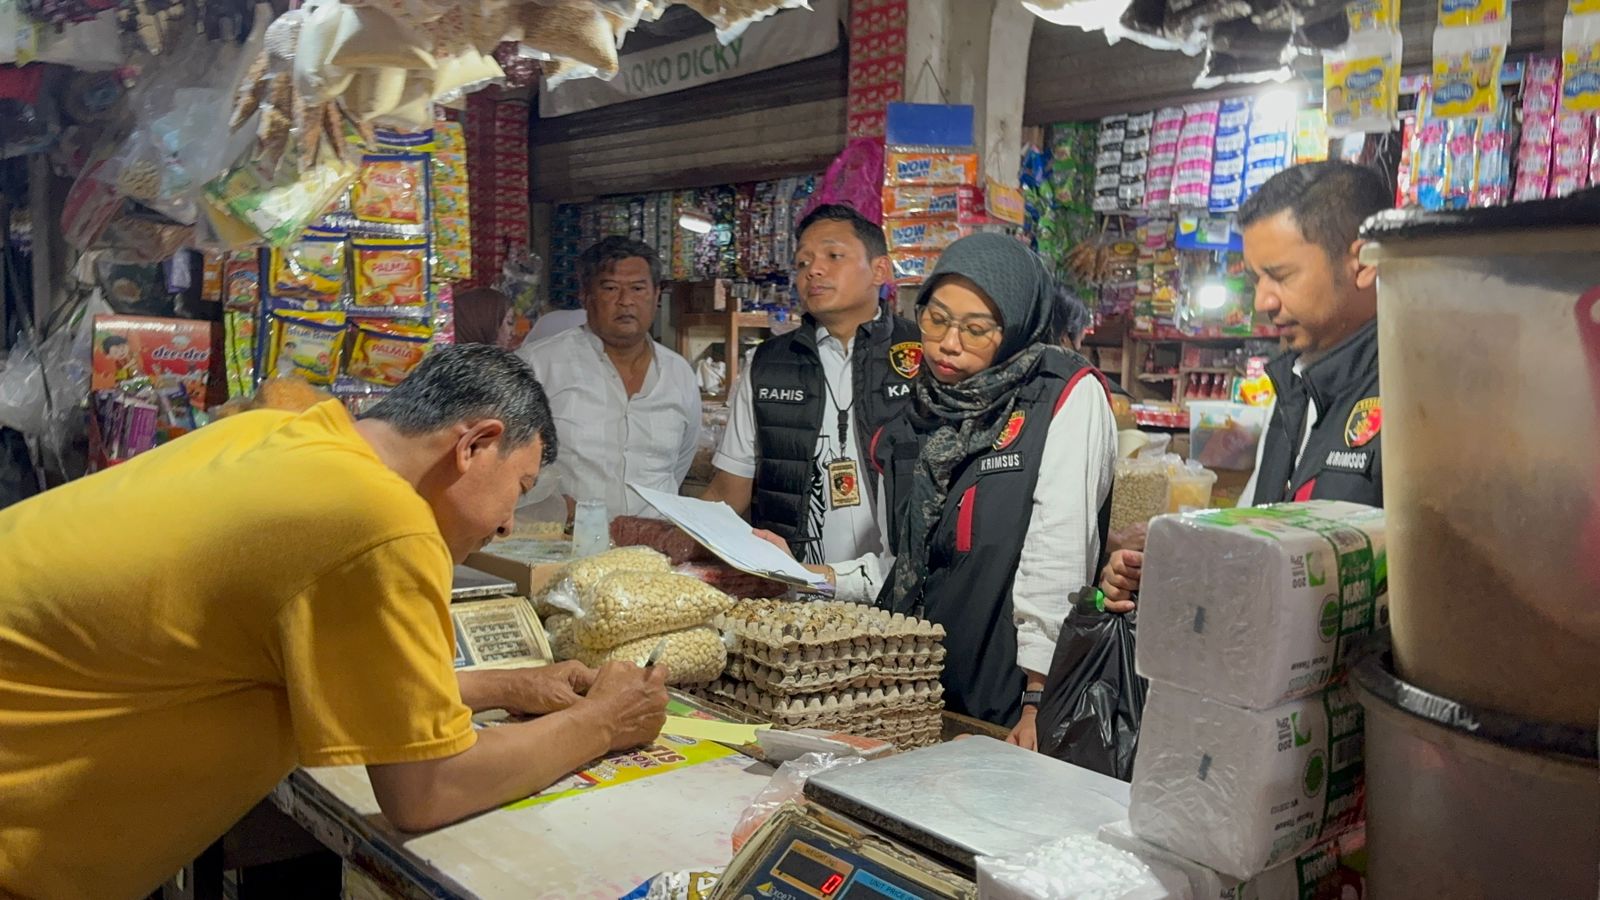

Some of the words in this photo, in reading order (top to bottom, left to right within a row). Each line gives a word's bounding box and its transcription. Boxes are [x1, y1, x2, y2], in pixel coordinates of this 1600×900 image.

[677, 37, 744, 81] DICKY
[897, 159, 931, 172] WOW
[372, 261, 412, 273] PALMIA
[371, 344, 413, 357] PALMIA
[759, 388, 804, 401] RAHIS
[981, 453, 1020, 470] KRIMSUS
[820, 874, 842, 895] 0
